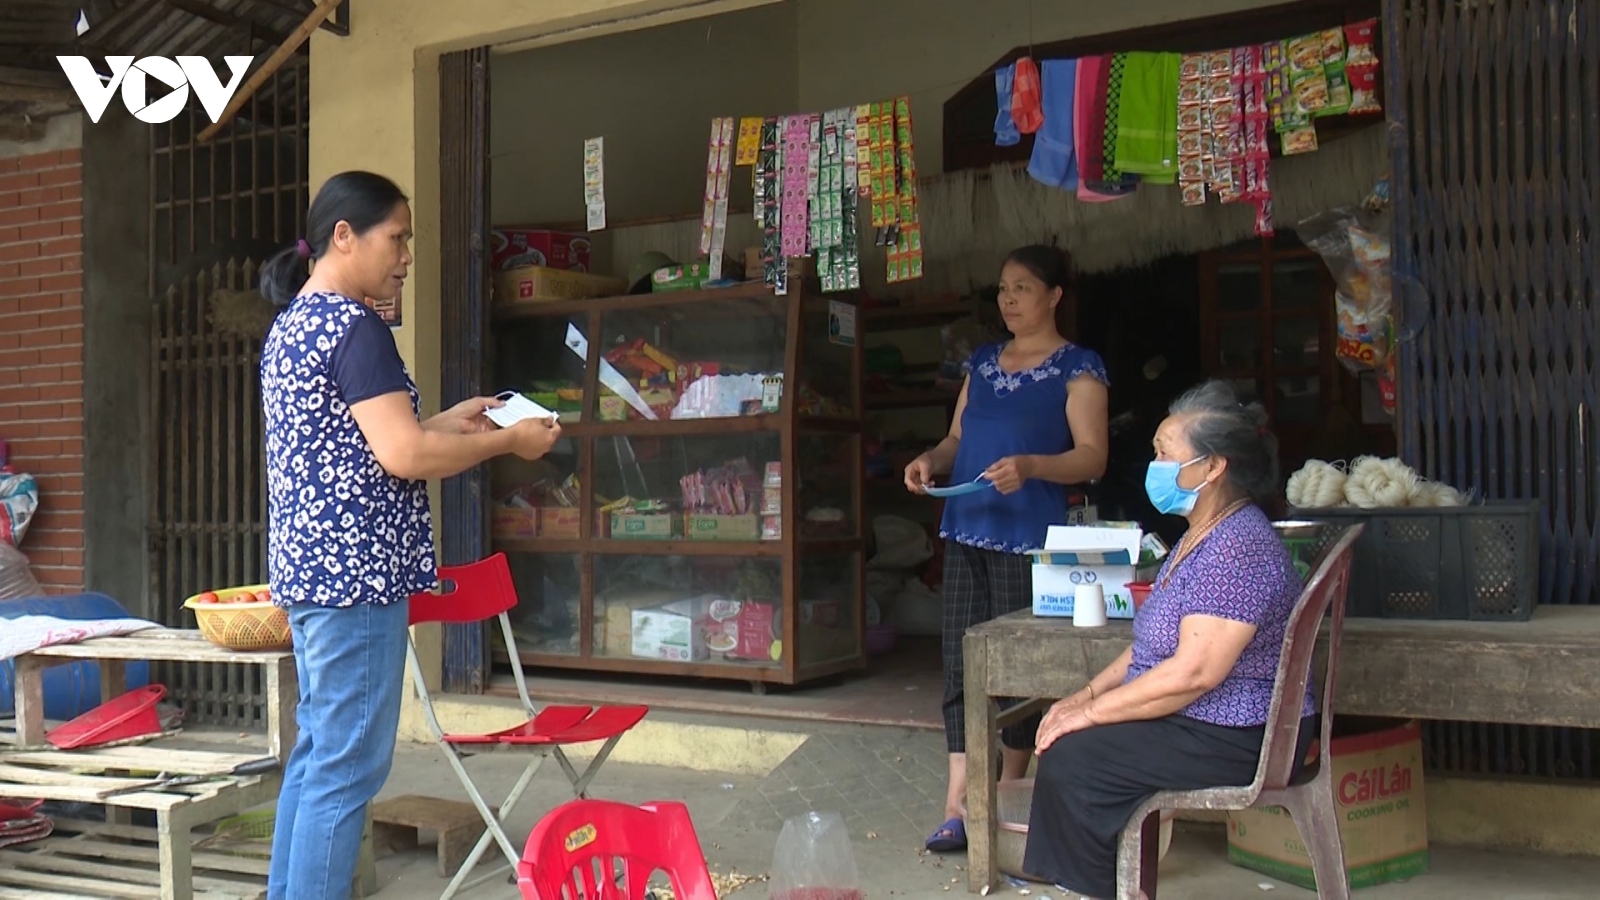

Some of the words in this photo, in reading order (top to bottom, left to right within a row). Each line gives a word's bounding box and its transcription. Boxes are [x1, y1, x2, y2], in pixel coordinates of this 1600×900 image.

[1060, 595, 1075, 605] ESH
[1347, 801, 1394, 821] COOKING
[1395, 798, 1411, 811] OIL
